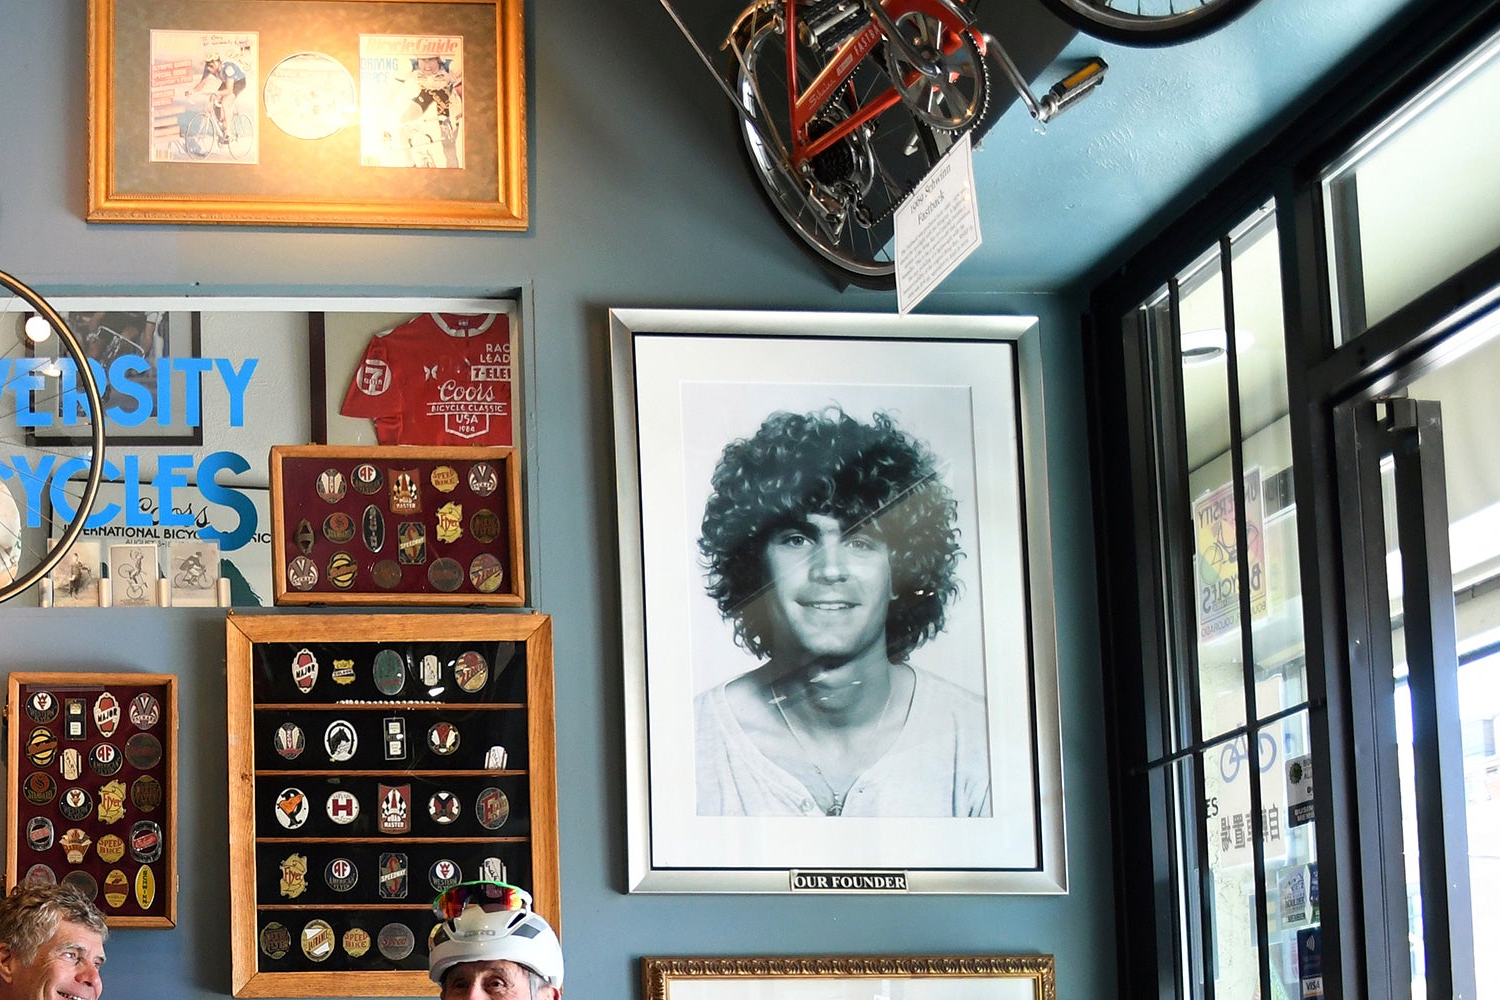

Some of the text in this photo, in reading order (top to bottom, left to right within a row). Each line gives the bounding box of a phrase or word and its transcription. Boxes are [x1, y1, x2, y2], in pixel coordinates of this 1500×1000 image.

[437, 380, 496, 402] Coors
[431, 405, 503, 413] BICYCLE CLASSIC
[455, 414, 479, 425] USA
[295, 663, 316, 679] MAJOR
[97, 707, 118, 723] MAJOR
[103, 791, 121, 812] Flyer
[332, 798, 354, 817] H
[99, 837, 122, 848] SPEED
[99, 846, 121, 854] BIKE
[284, 866, 302, 886] Flyer
[380, 869, 406, 882] SPEEDWAY
[794, 876, 906, 888] OUR FOUNDER
[344, 932, 369, 942] SPEED
[345, 940, 368, 948] BIKE
[1306, 981, 1321, 992] VISA
